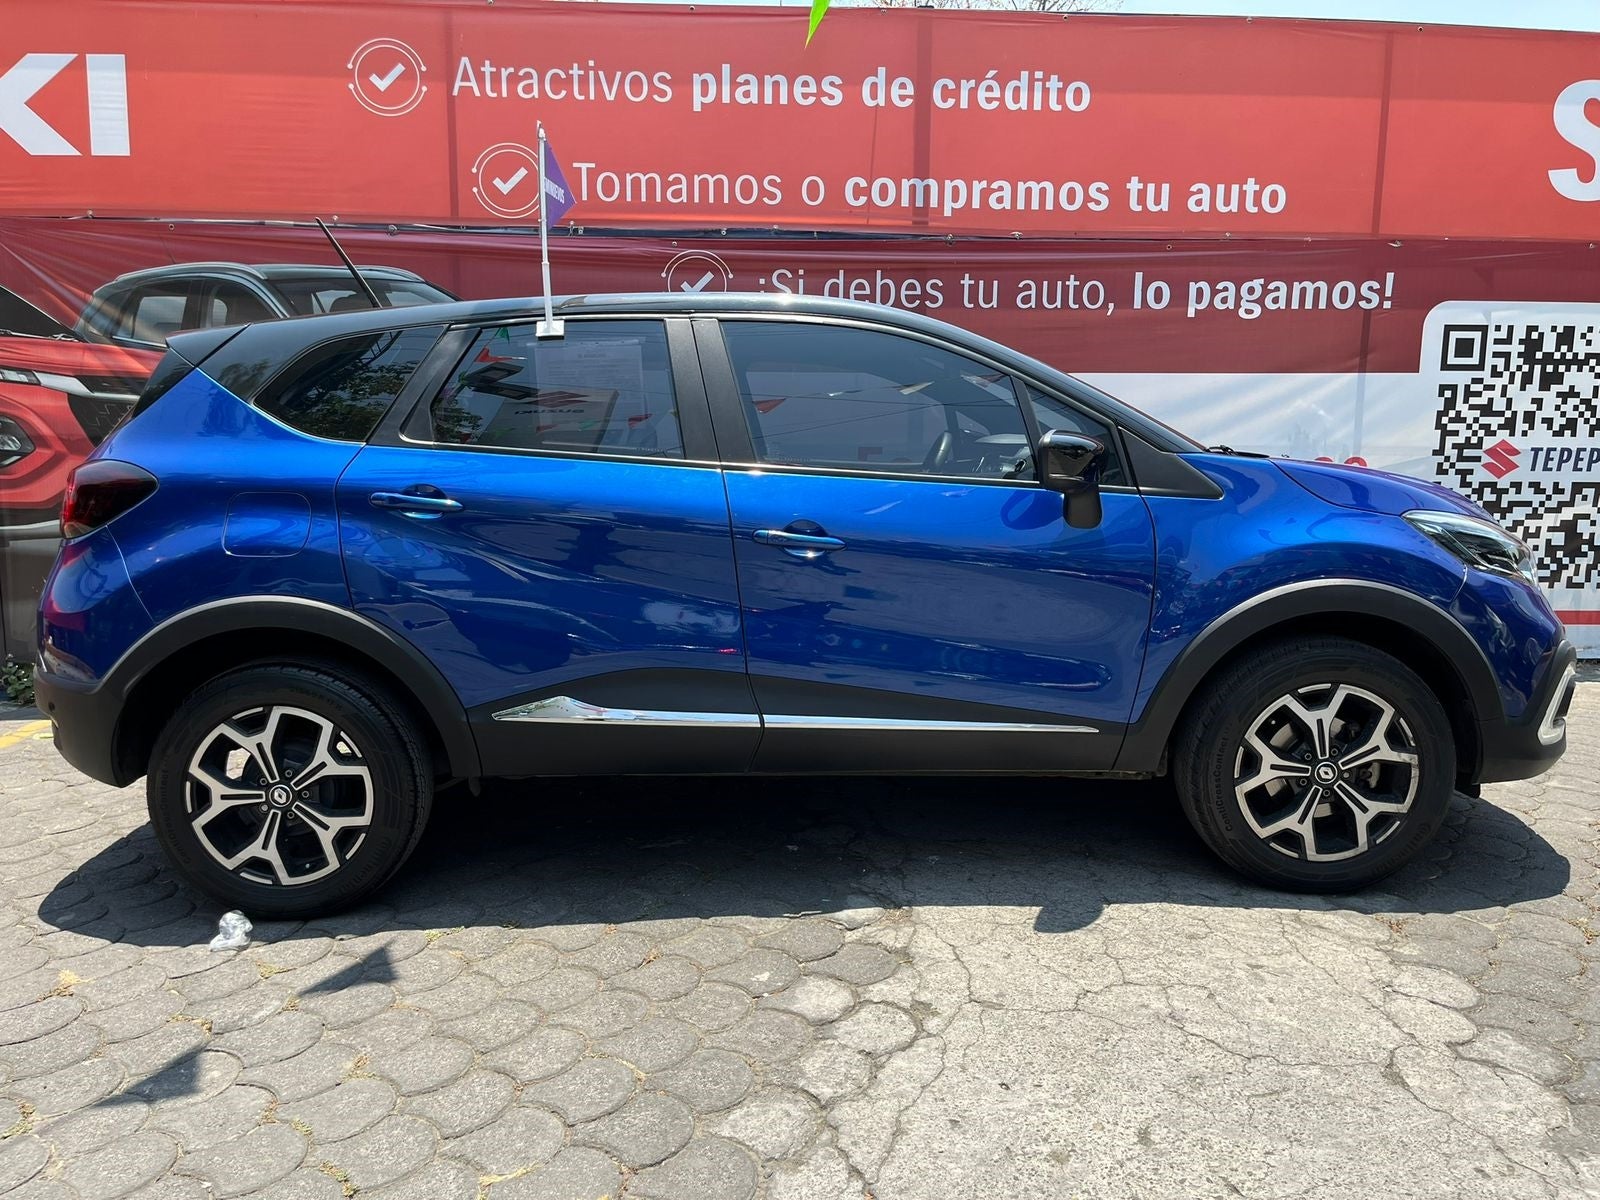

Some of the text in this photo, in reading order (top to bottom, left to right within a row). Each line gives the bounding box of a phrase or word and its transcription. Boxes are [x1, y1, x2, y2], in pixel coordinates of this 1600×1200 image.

[453, 57, 1091, 112] Atractivos planes de crédito
[573, 162, 1287, 217] Tomamos o compramos tu auto
[823, 269, 944, 309] debes
[960, 274, 998, 309] tu
[1016, 275, 1115, 316] auto,
[1133, 271, 1171, 309] lo
[1187, 272, 1395, 320] pagamos!
[1530, 446, 1600, 472] TEPEP
